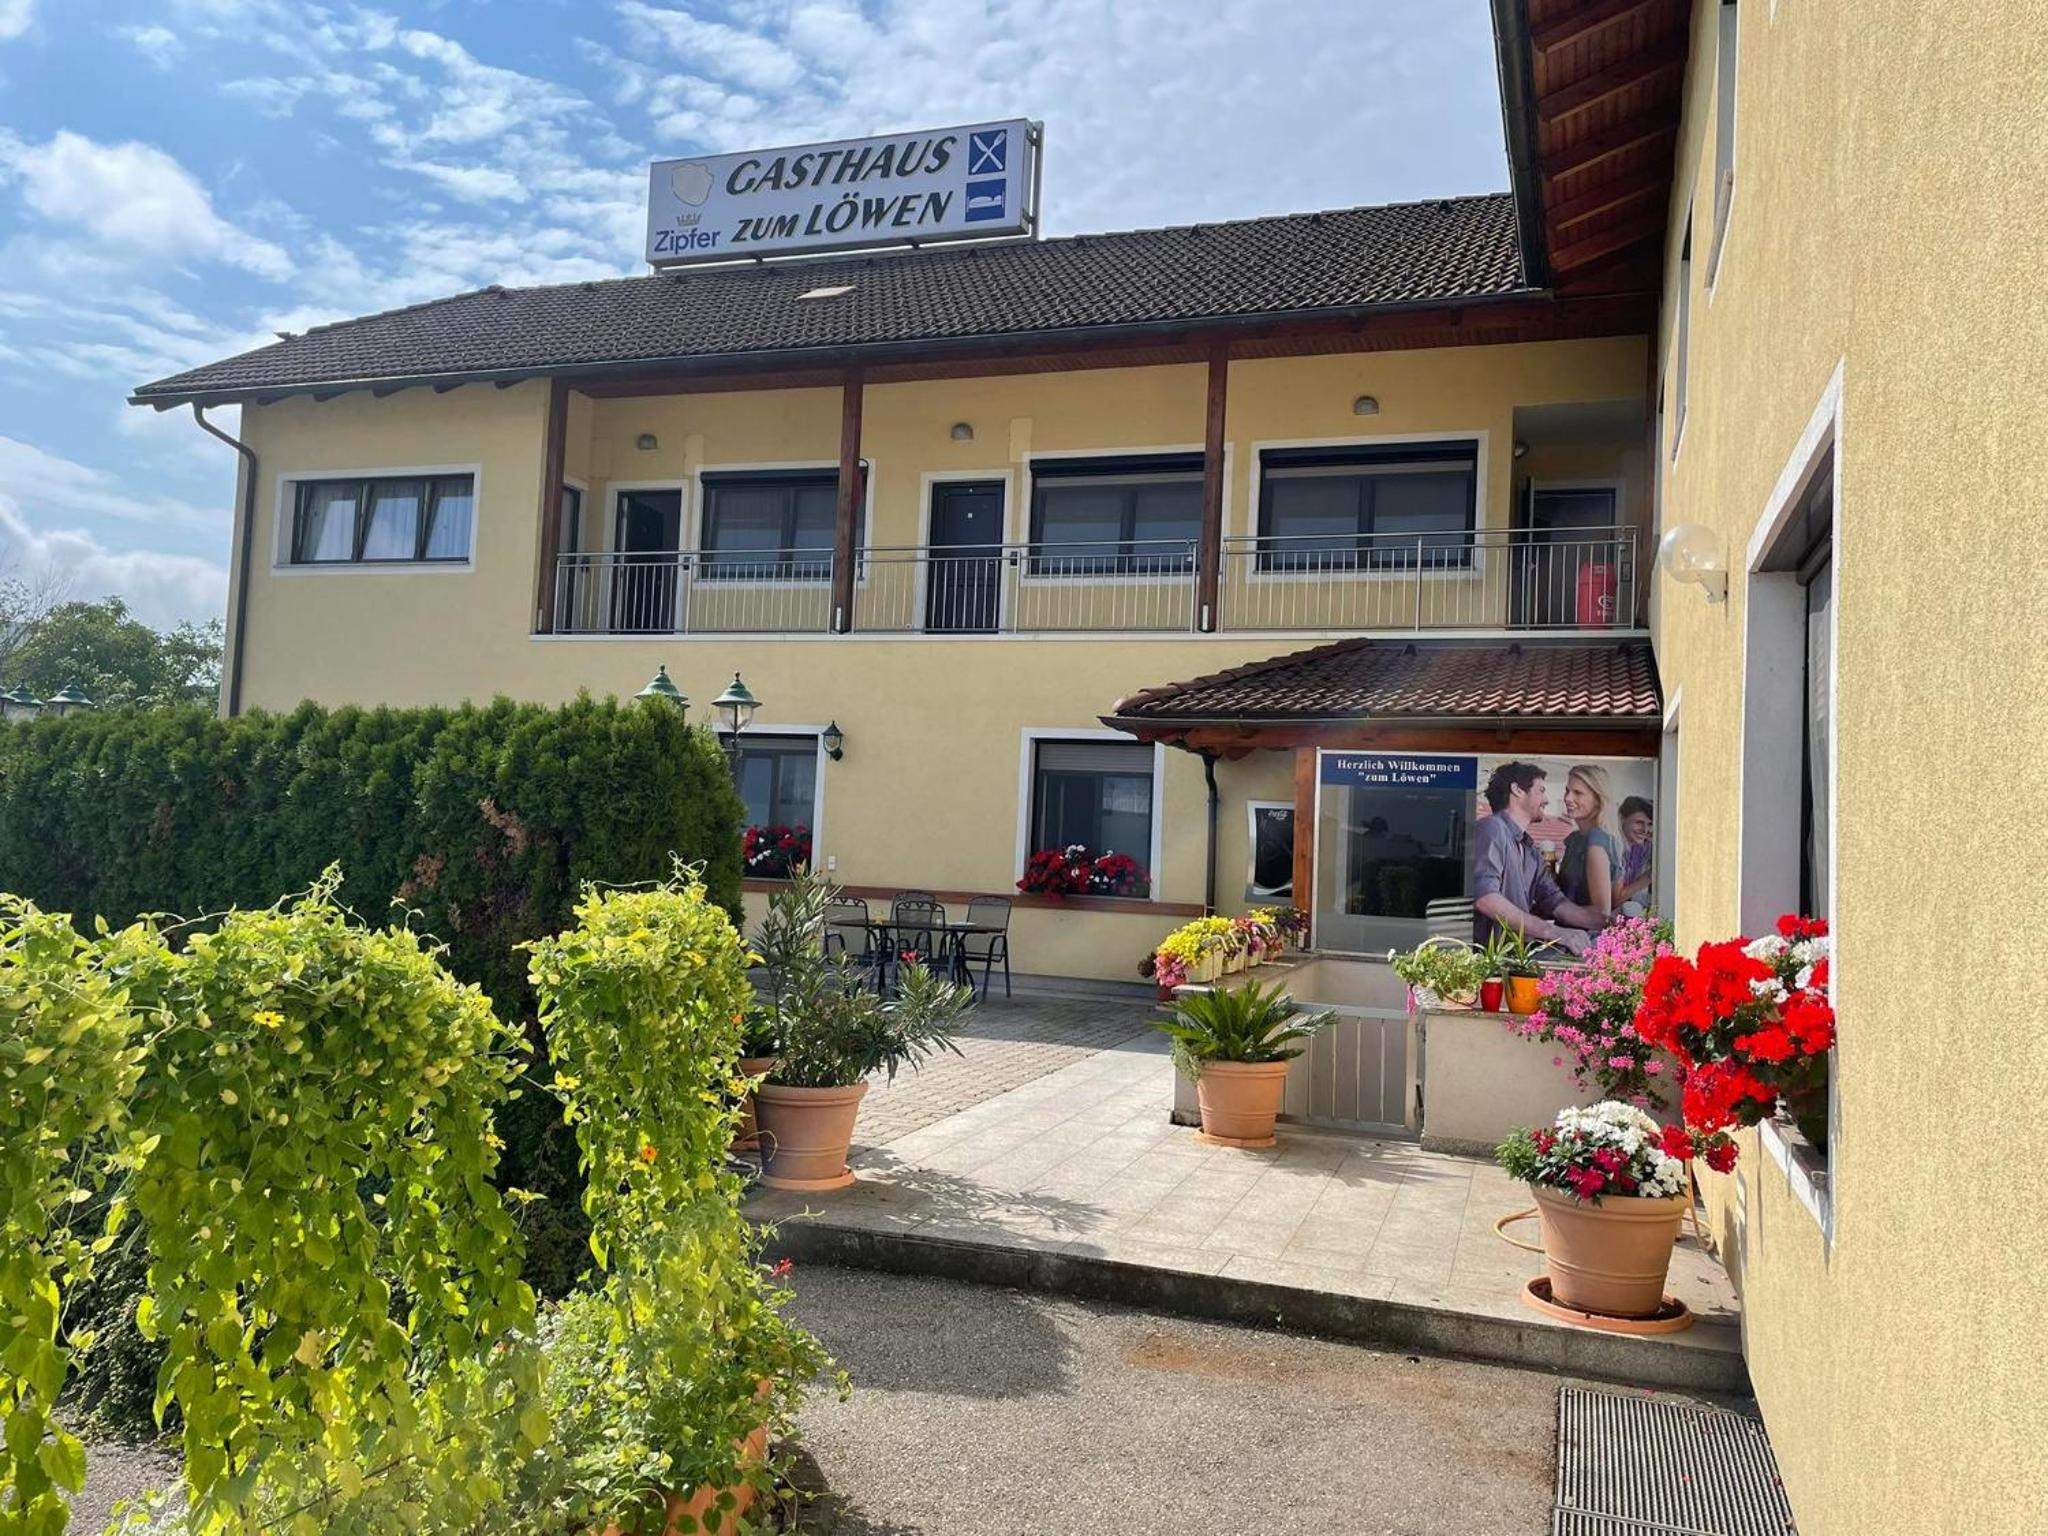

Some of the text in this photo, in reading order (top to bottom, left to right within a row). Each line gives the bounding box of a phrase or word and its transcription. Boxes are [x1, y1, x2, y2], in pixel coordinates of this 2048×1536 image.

[725, 136, 958, 196] GASTHAUS
[730, 191, 954, 243] ZUM LÖWEN
[653, 227, 722, 255] Zipfer
[1337, 759, 1461, 772] Herzlich Willkommen
[1357, 771, 1437, 783] "zum Löwen"
